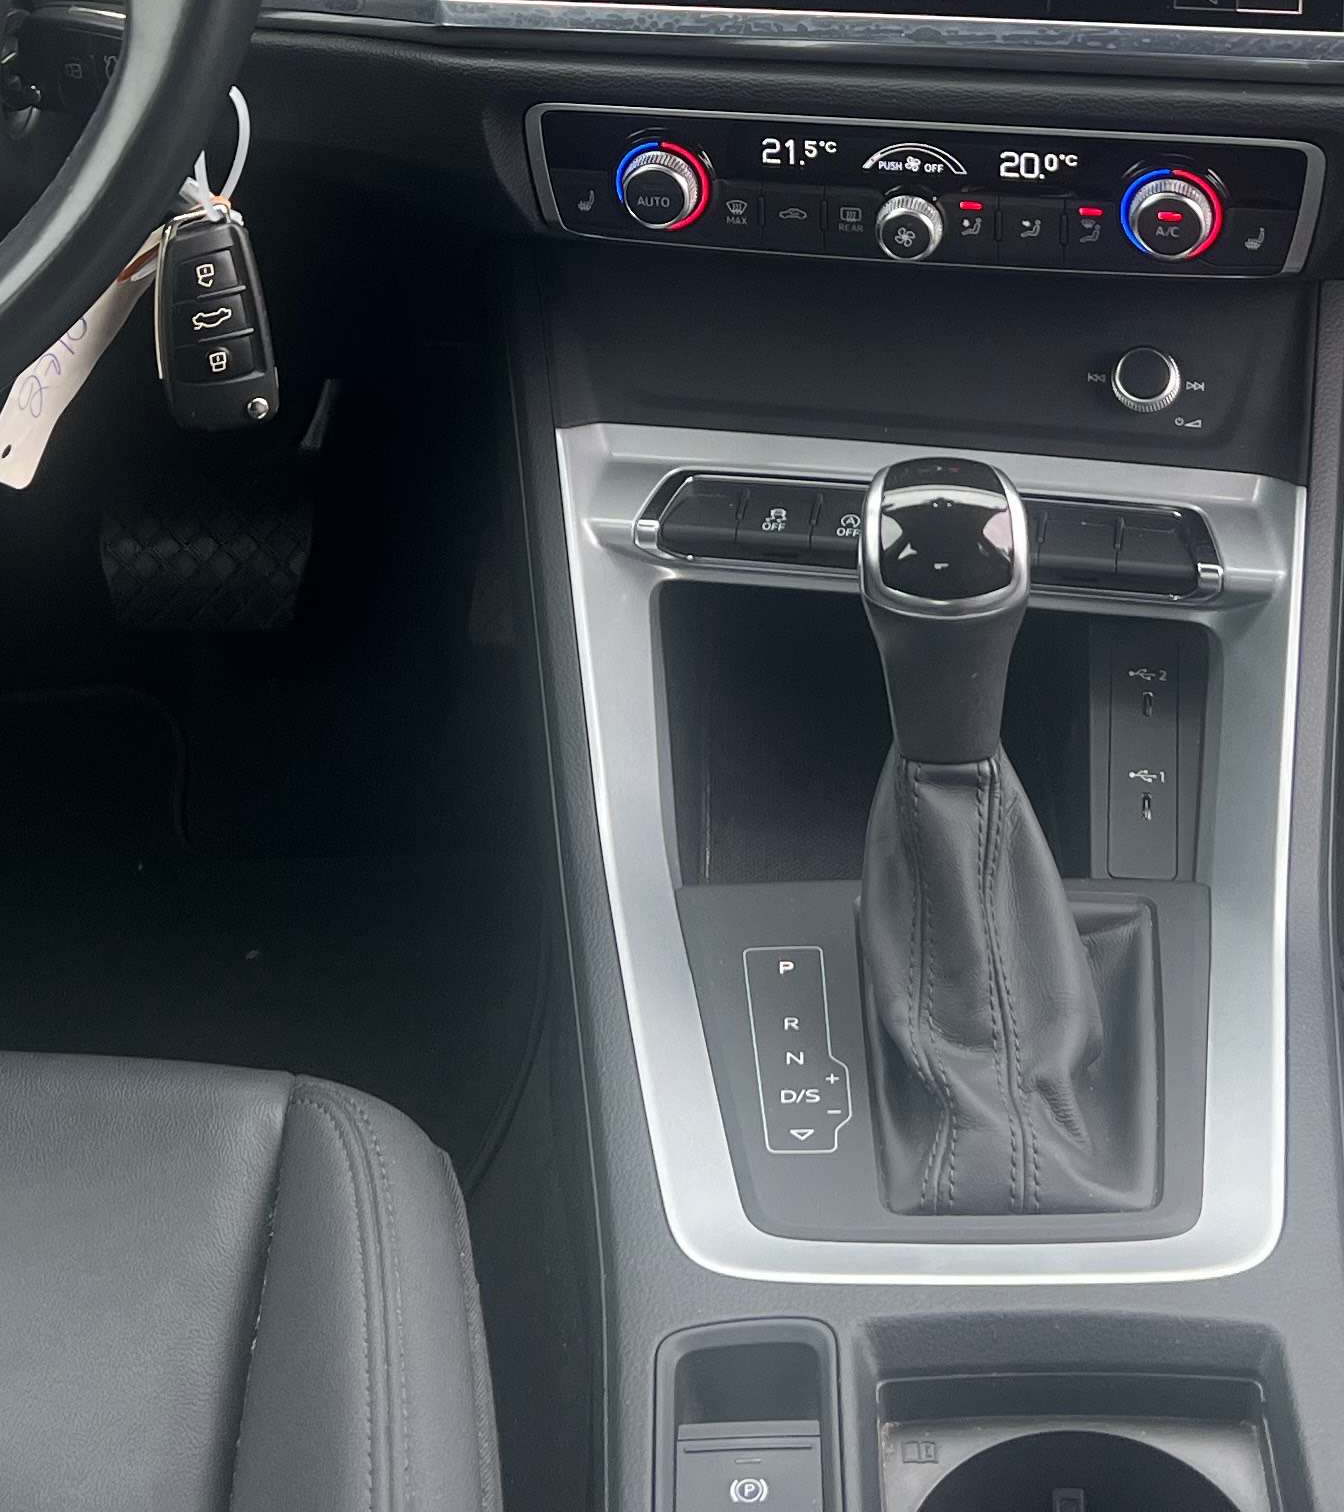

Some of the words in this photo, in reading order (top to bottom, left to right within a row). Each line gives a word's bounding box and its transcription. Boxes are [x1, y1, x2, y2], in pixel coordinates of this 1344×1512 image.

[878, 160, 903, 171] PUSH
[924, 163, 944, 173] OFF
[637, 196, 670, 209] AUTO
[726, 215, 747, 225] MAX
[838, 223, 864, 233] REAR
[1155, 225, 1180, 239] A/C
[761, 521, 786, 532] OFF
[836, 527, 861, 537] OFF
[1159, 669, 1168, 682] 2
[1159, 771, 1165, 783] 1
[779, 961, 794, 975] P
[784, 1017, 800, 1031] R
[786, 1051, 804, 1065] N
[780, 1089, 821, 1104] D/S
